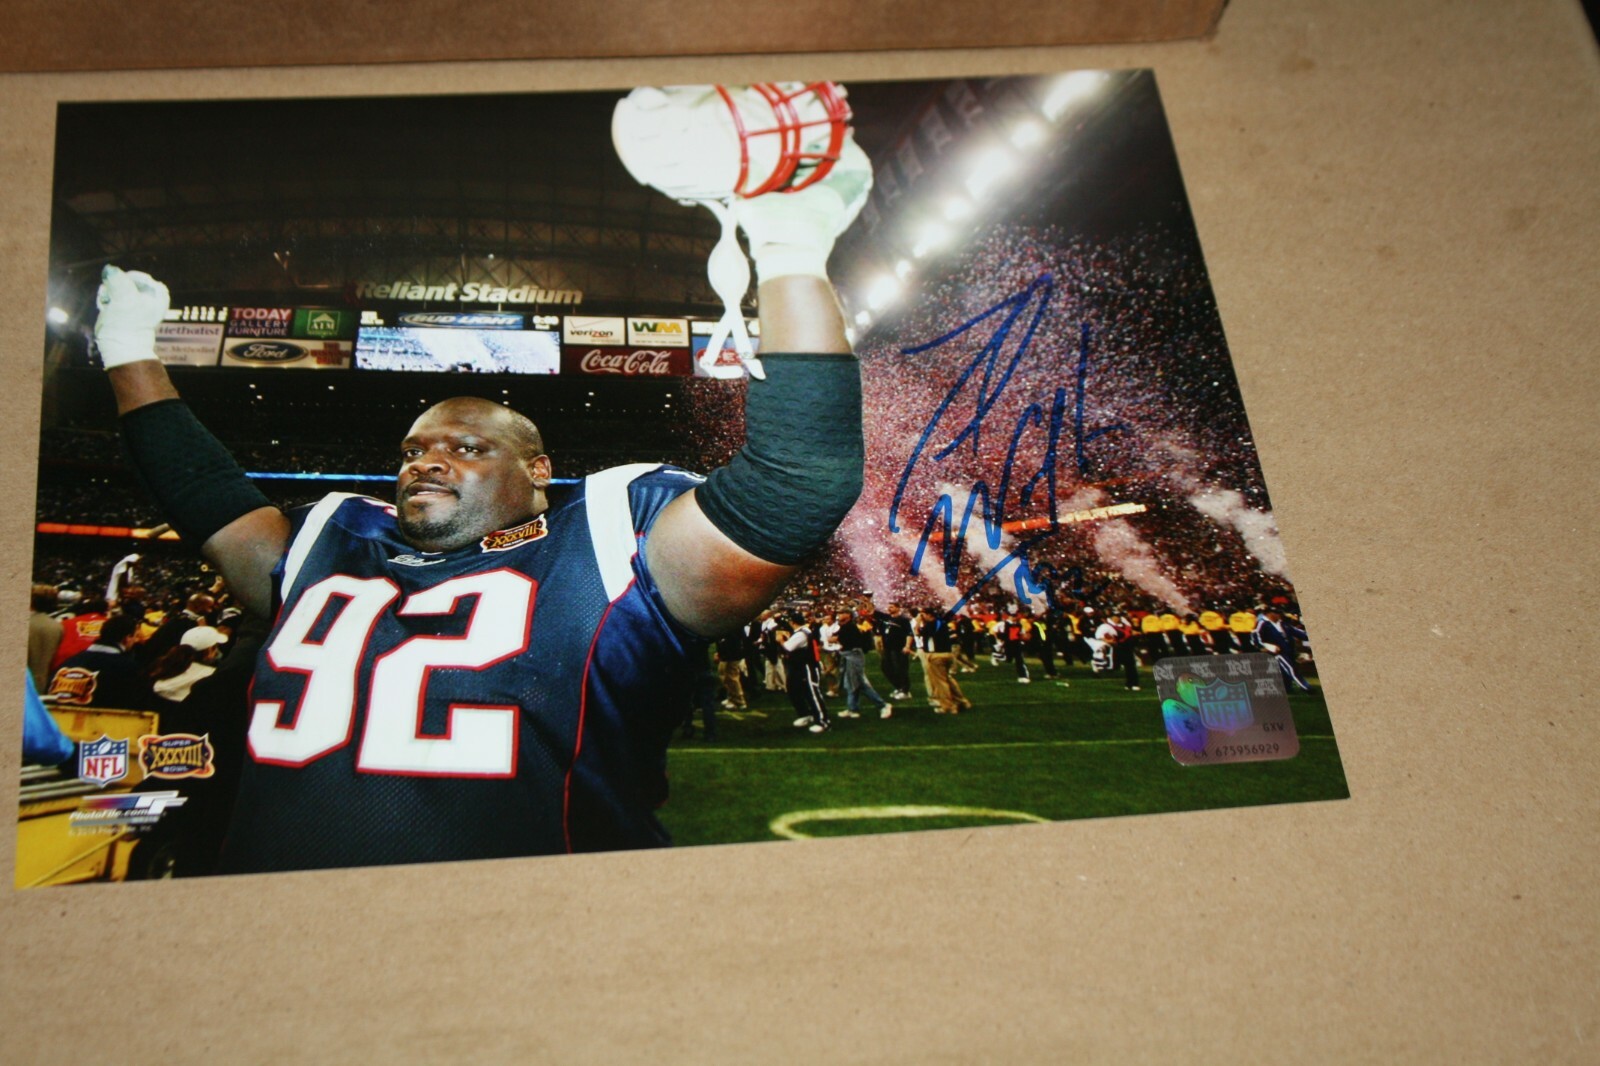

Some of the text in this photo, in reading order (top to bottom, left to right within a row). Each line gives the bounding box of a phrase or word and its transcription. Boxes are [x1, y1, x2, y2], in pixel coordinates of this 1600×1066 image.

[356, 282, 583, 305] Reliant Stadium
[231, 308, 292, 320] TODAY
[408, 314, 457, 324] BUD
[458, 315, 521, 326] LIGHT
[229, 320, 289, 328] GALLERY
[632, 321, 683, 334] WM
[228, 327, 288, 337] FURNITURE
[570, 329, 614, 338] verizon
[243, 343, 289, 359] Ford
[581, 348, 672, 375] Coca-Cola
[247, 566, 538, 779] 92
[1262, 722, 1285, 732] GXW
[162, 739, 192, 748] SUPER
[150, 744, 204, 768] XXXVIII
[1215, 743, 1280, 758] 675956929
[85, 756, 123, 779] NFL
[163, 765, 190, 773] BOWL
